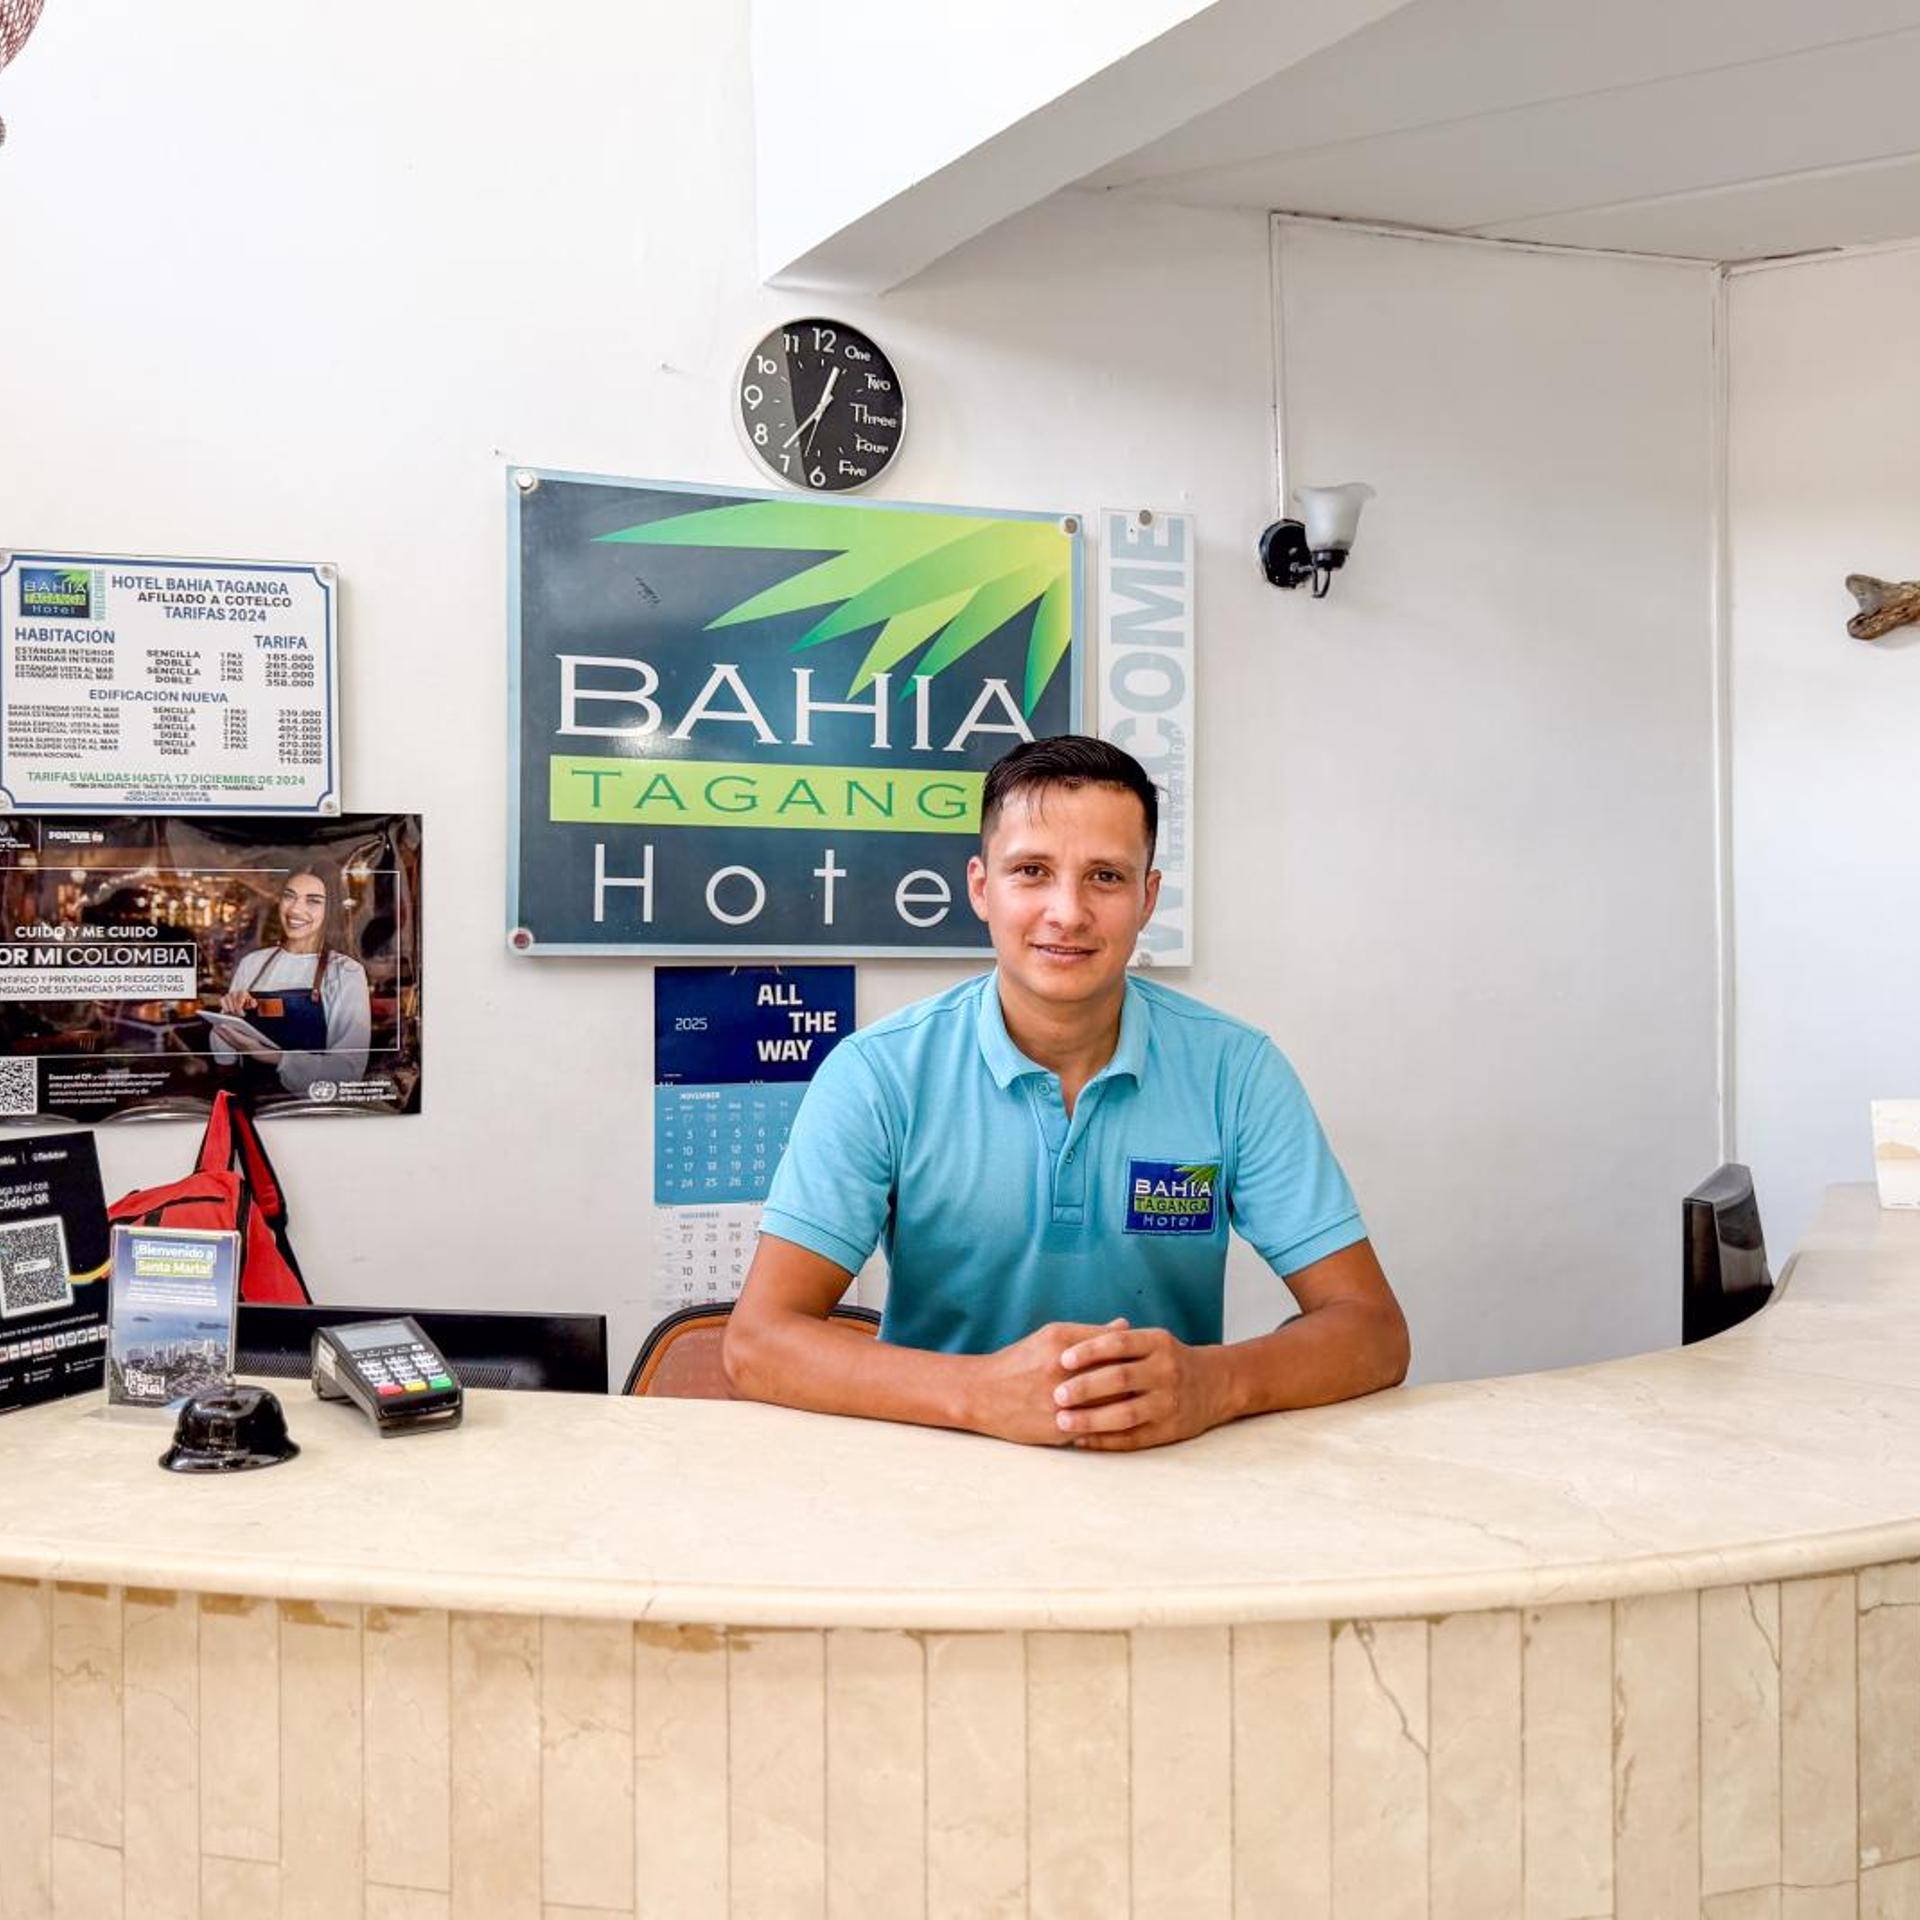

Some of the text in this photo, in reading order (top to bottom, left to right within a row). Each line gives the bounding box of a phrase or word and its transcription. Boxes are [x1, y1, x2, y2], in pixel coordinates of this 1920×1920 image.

[783, 333, 799, 354] 11
[812, 327, 837, 353] 12
[845, 345, 872, 362] One
[756, 355, 777, 375] 10
[864, 373, 891, 391] Two
[744, 385, 763, 411] 9
[850, 403, 897, 428] Three
[754, 423, 768, 446] 8
[855, 434, 889, 454] Four
[779, 454, 790, 473] 7
[839, 460, 867, 477] Five
[810, 466, 826, 487] 6
[112, 575, 289, 595] HOTEL BAHIA TAGANGA
[138, 592, 292, 608] AFILIADO A COTELCO
[164, 606, 267, 622] TARIFAS 2024
[253, 635, 308, 649] TARIFA
[146, 650, 200, 658] SENCILLA
[155, 658, 192, 667] DOBLE
[146, 667, 200, 676] SENCILLA
[155, 676, 192, 684] DOBLE
[182, 692, 229, 703] NUEVA
[555, 654, 1037, 752] BAHIA
[153, 707, 196, 715] SENCILLA
[160, 714, 189, 722] DOBLE
[153, 723, 196, 731] SENCILLA
[160, 731, 189, 739] DOBLE
[1109, 513, 1185, 954] WCOME
[153, 740, 196, 748] SENCILLA
[160, 748, 189, 756] DOBLE
[28, 772, 79, 782] TARIFAS
[133, 773, 171, 783] HASTA
[175, 774, 188, 784] 17
[191, 774, 256, 785] DICIEMBRE
[258, 775, 273, 786] DE
[276, 775, 306, 786] 2024
[571, 769, 970, 821] TAGANG
[593, 843, 951, 928] Hote
[15, 926, 158, 938] CUIDO Y ME CUIDO
[0, 947, 191, 965] OR MI COLOMBIA
[0, 975, 184, 984] NTIFICO Y PREVENGO LOS RIESGOS DEL
[0, 984, 185, 994] NSUMO DE SUSTANCIAS PSICOACTIVAS
[758, 984, 803, 1006] ALL
[675, 1018, 708, 1030] 2025
[789, 1011, 837, 1032] THE
[758, 1040, 812, 1061] WAY
[680, 1091, 720, 1100] NOVEMBER
[710, 1128, 717, 1138] 4
[734, 1128, 741, 1138] 5
[758, 1127, 765, 1137] 6
[682, 1146, 693, 1156] 10
[708, 1145, 717, 1154] 11
[684, 1162, 694, 1172] 17
[1135, 1178, 1212, 1197] BAHIA
[33, 1192, 49, 1205] QR
[1136, 1197, 1208, 1211] TAGANGA
[134, 1242, 213, 1259] ¡Bienvenido a
